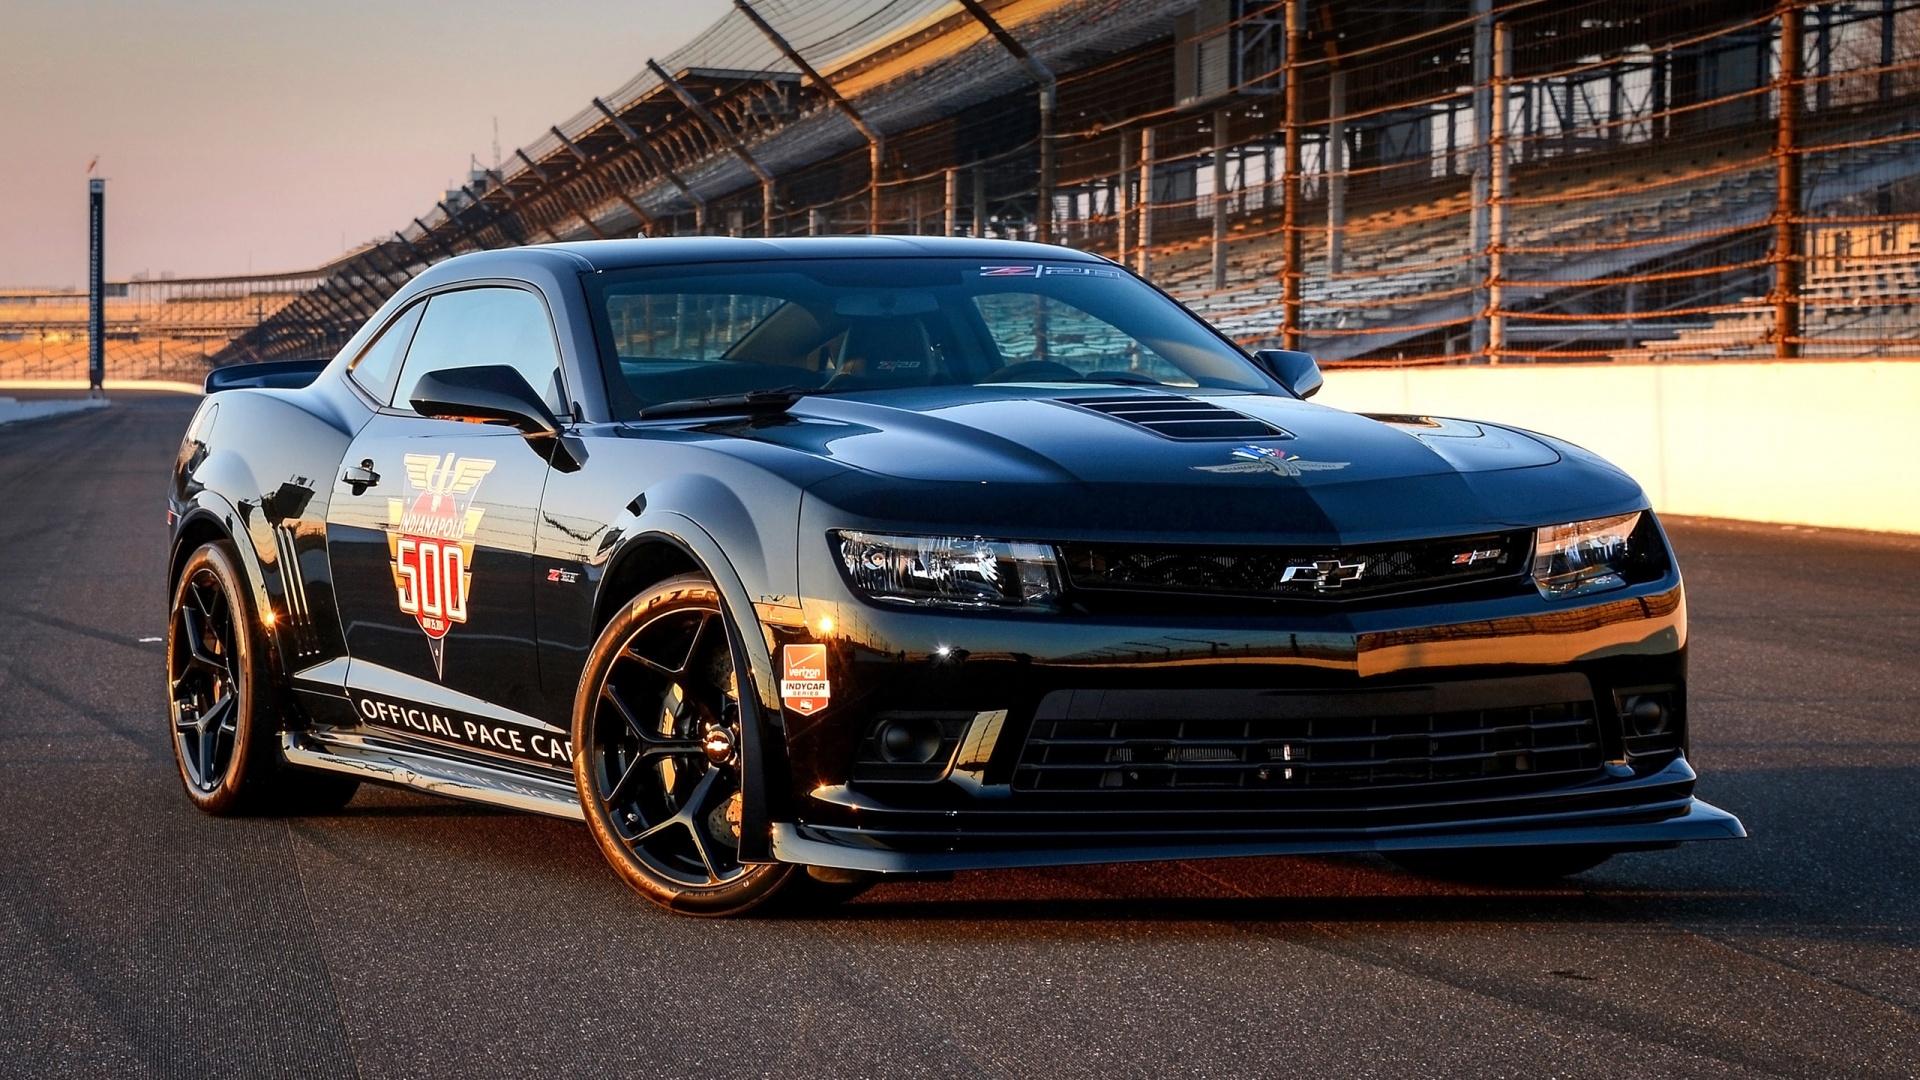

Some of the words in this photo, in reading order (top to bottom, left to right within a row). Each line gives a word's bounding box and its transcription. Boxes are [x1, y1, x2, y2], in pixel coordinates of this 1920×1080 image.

[399, 512, 466, 539] INDIANAPOLIS
[396, 539, 468, 624] 500
[785, 682, 825, 690] INDYCAR
[789, 666, 820, 679] verizon
[361, 699, 461, 738] OFFICIAL
[463, 721, 526, 752] PACE
